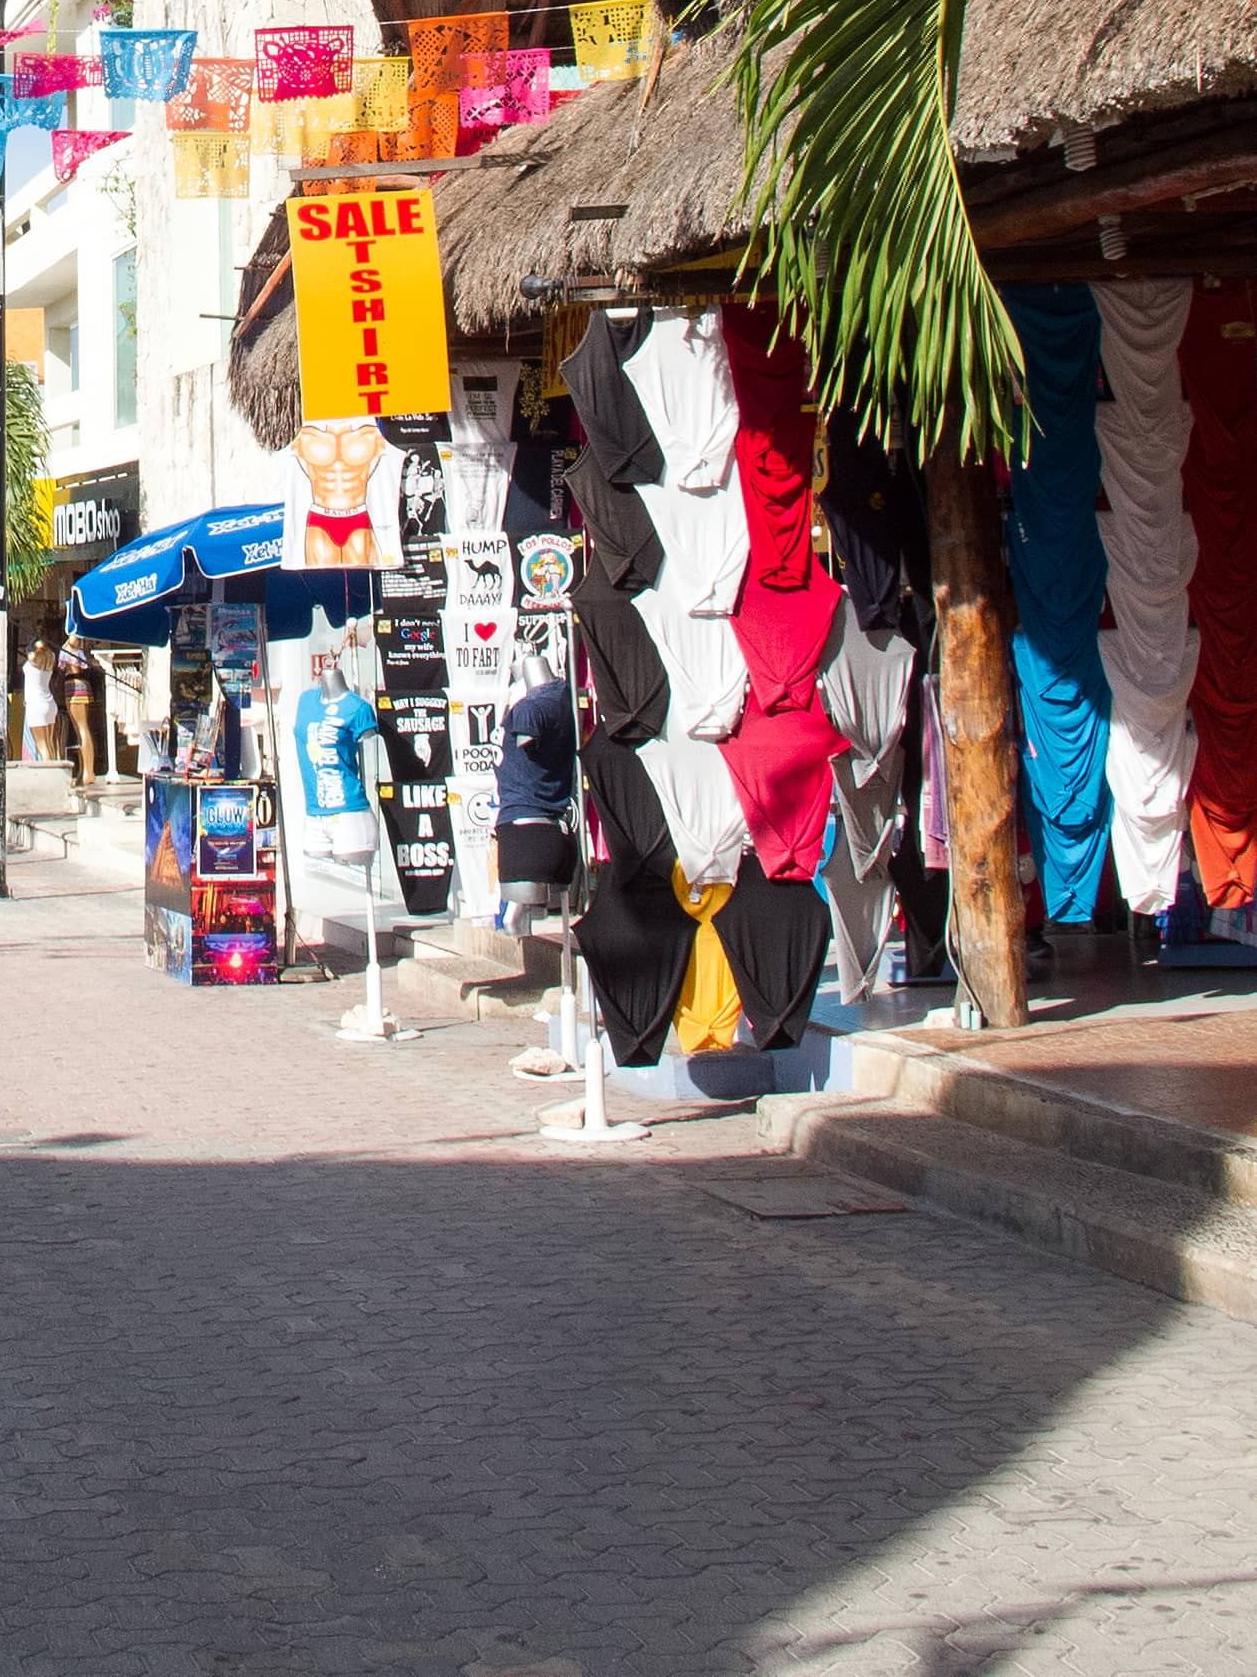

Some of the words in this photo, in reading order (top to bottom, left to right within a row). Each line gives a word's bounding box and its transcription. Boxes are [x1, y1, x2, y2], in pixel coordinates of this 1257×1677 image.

[297, 198, 424, 241] SALE
[97, 498, 120, 552] shop
[242, 539, 283, 566] Xel-H
[462, 539, 507, 556] HUMP
[401, 619, 421, 627] don't
[400, 628, 435, 642] Google
[464, 623, 469, 643] I
[417, 642, 434, 651] wife
[456, 648, 469, 668] TO
[472, 647, 499, 668] FART
[393, 698, 409, 711] MAY
[415, 696, 448, 709] SUGGEST
[414, 708, 427, 718] THE
[396, 716, 446, 733] SAUSAGE
[462, 747, 493, 760] POO
[464, 760, 494, 772] TODA
[402, 784, 447, 808] LIKE
[207, 803, 246, 825] GLOW
[418, 813, 434, 838] A
[396, 841, 455, 867] BOSS.
